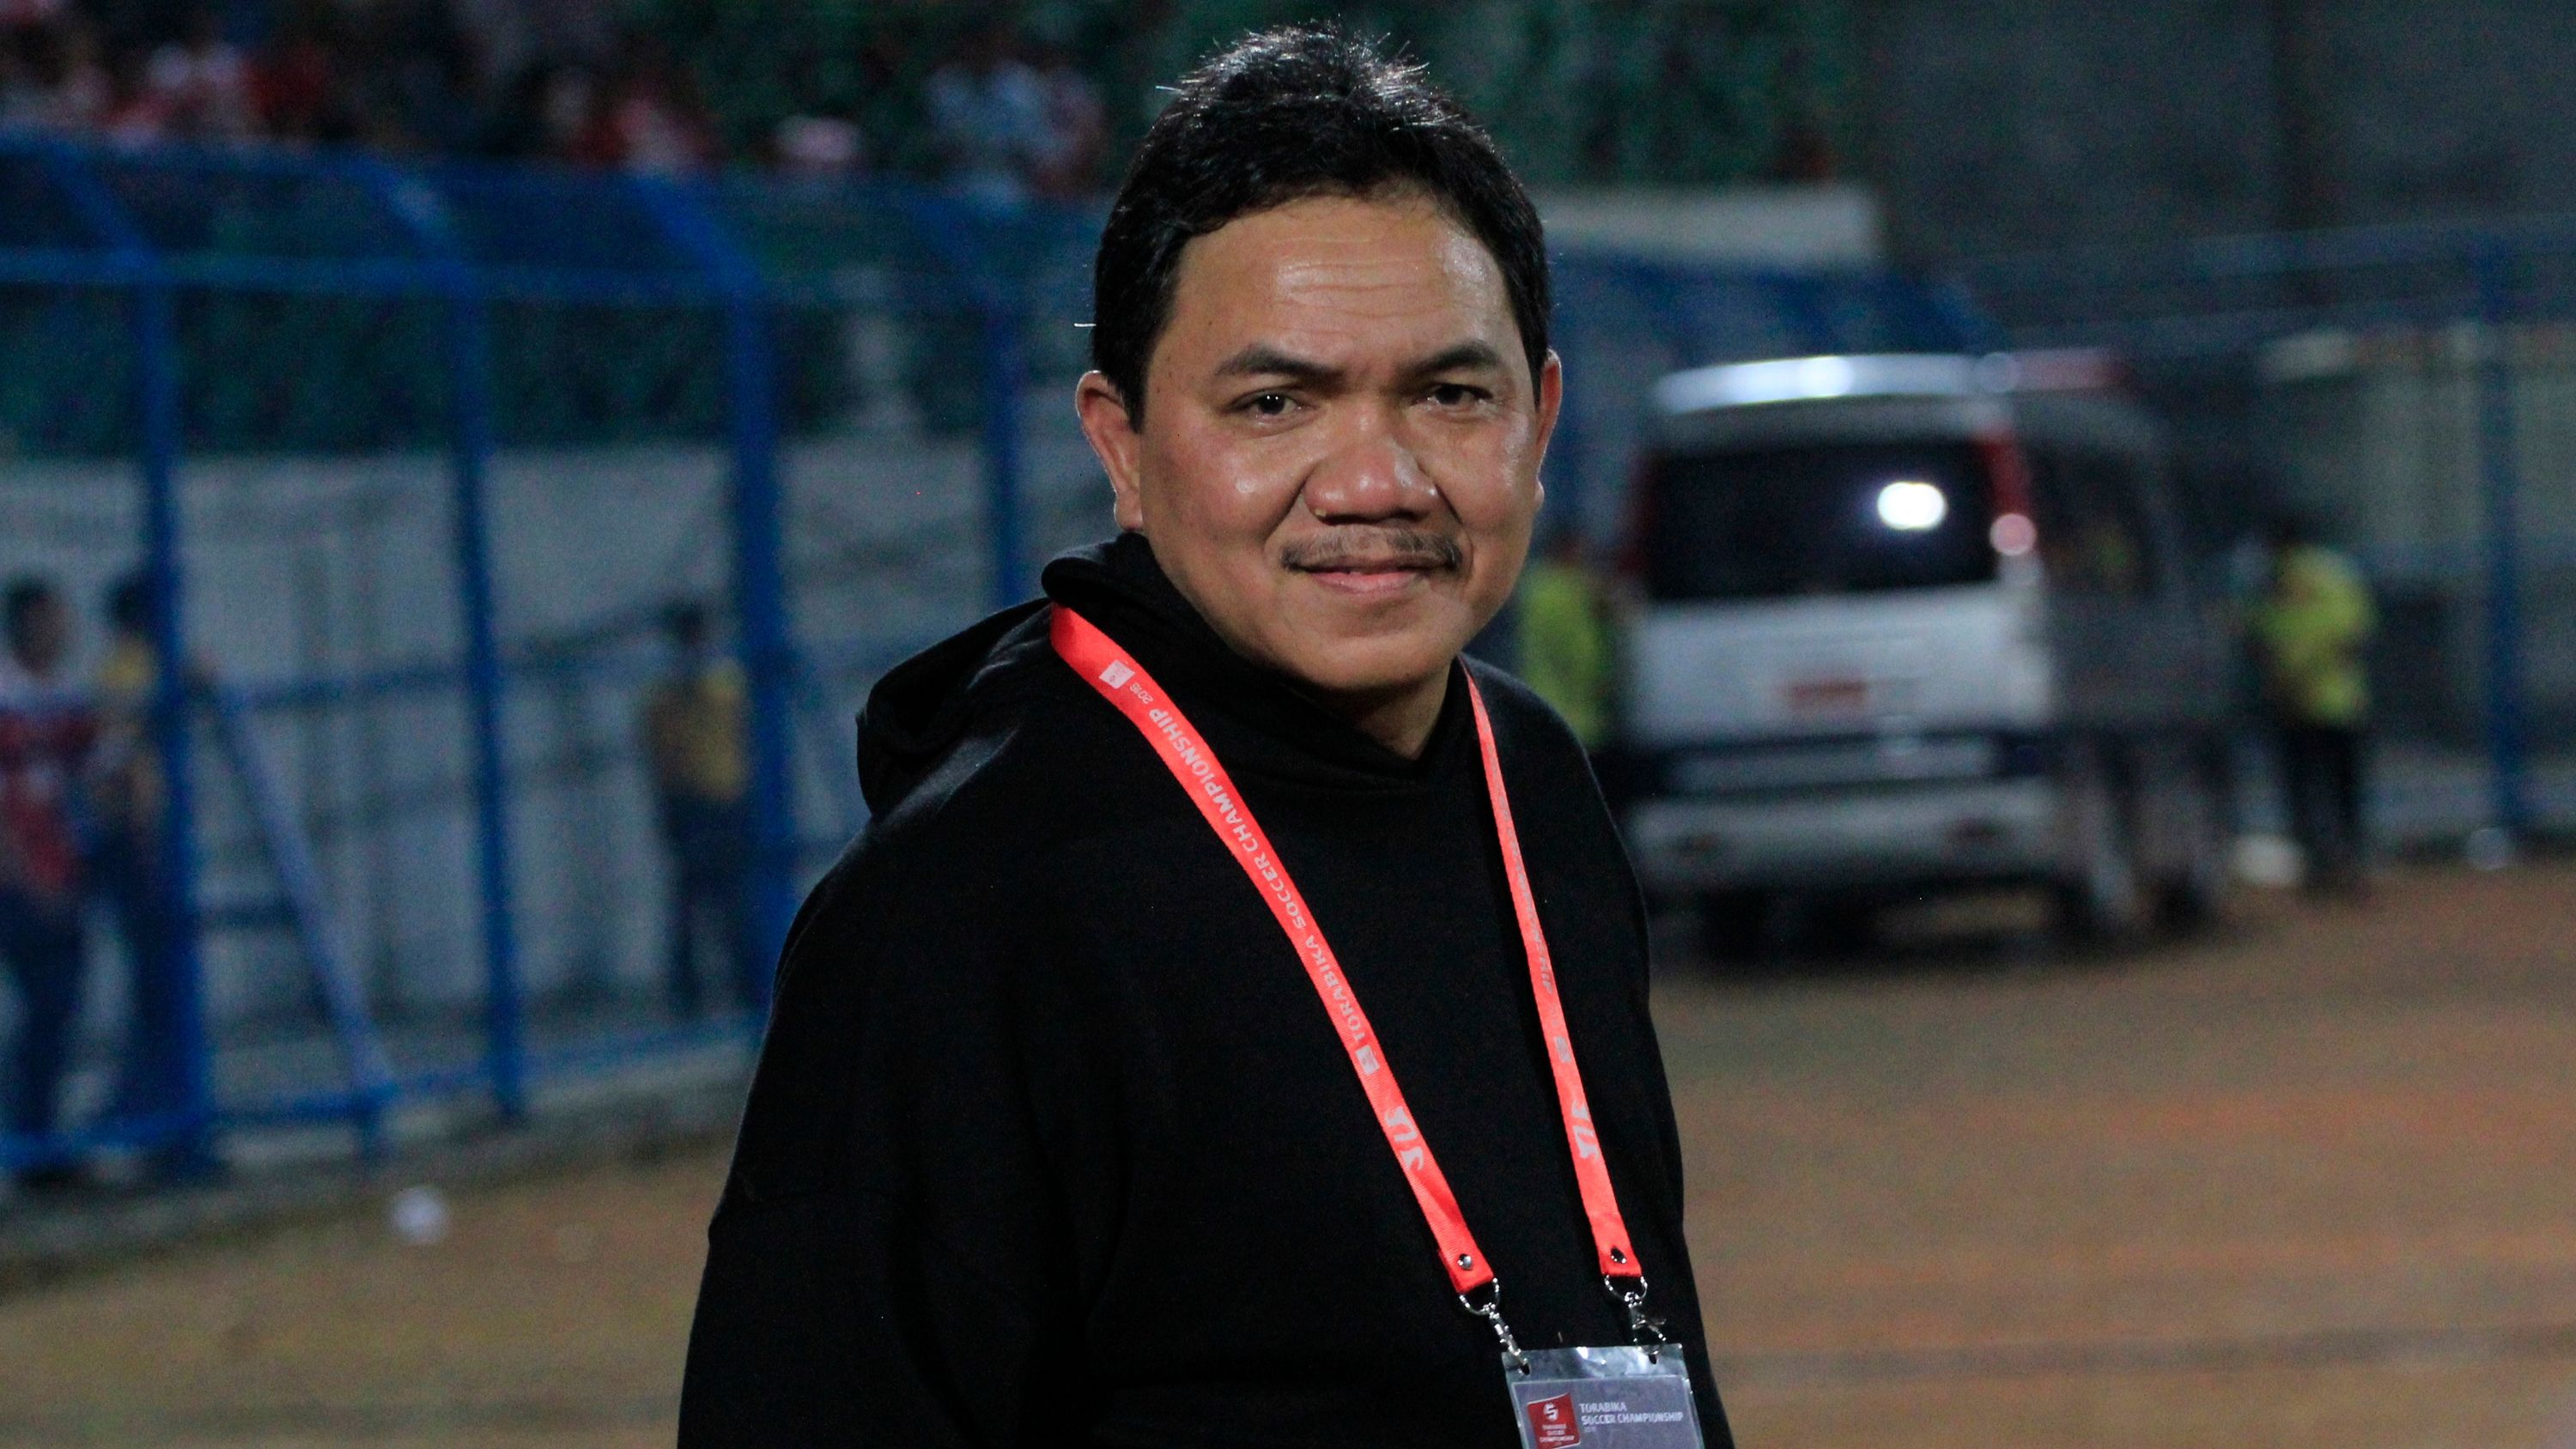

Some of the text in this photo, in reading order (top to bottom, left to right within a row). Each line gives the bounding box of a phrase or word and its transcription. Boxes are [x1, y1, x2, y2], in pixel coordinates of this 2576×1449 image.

[1149, 708, 1259, 852] CHAMPIONSHIP
[1254, 852, 1306, 929] SOCCER
[1305, 935, 1366, 1043] TORABIKA
[1579, 1402, 1627, 1414] TORABIKA
[1581, 1411, 1684, 1426] SOCCER CHAMPIONSHIP
